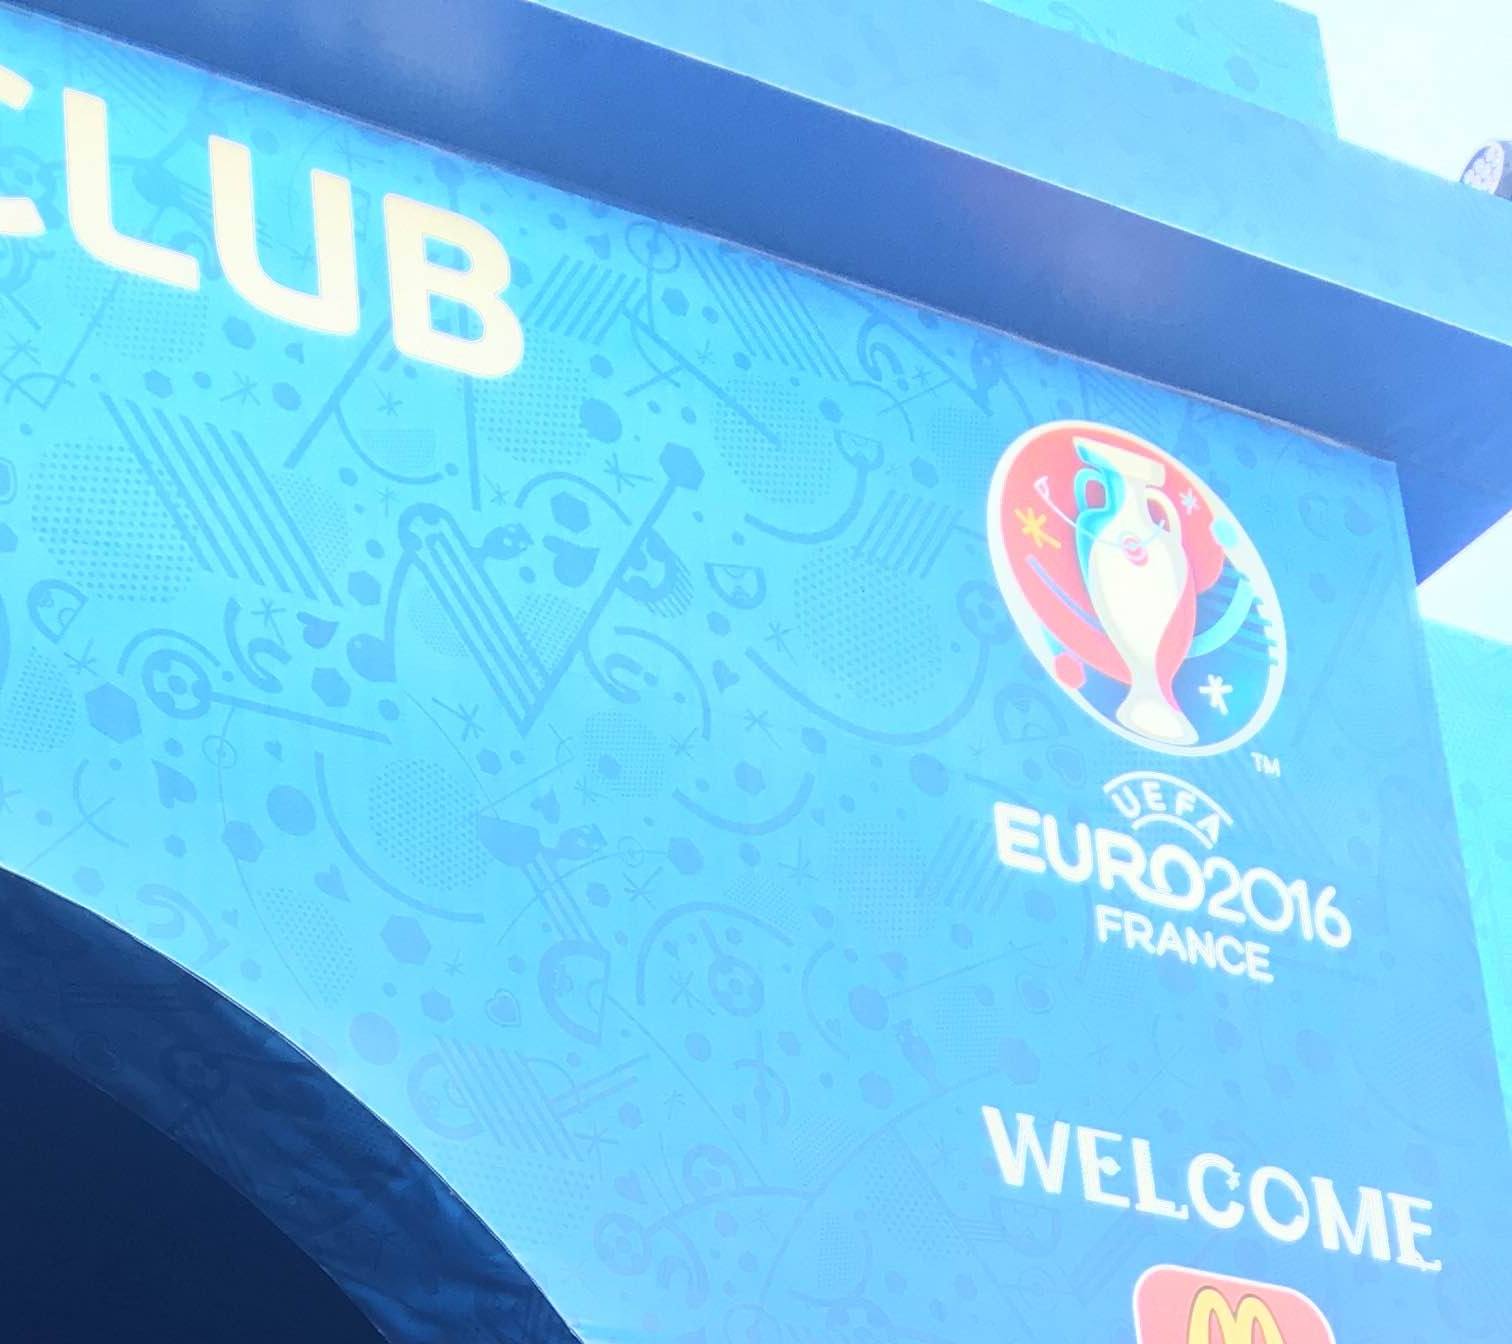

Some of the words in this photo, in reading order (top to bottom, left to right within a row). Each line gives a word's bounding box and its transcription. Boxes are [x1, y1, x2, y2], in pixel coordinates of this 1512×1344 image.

[1110, 780, 1222, 845] UEFA
[1094, 904, 1274, 984] FRANCE
[981, 1105, 1442, 1271] WELCOME
